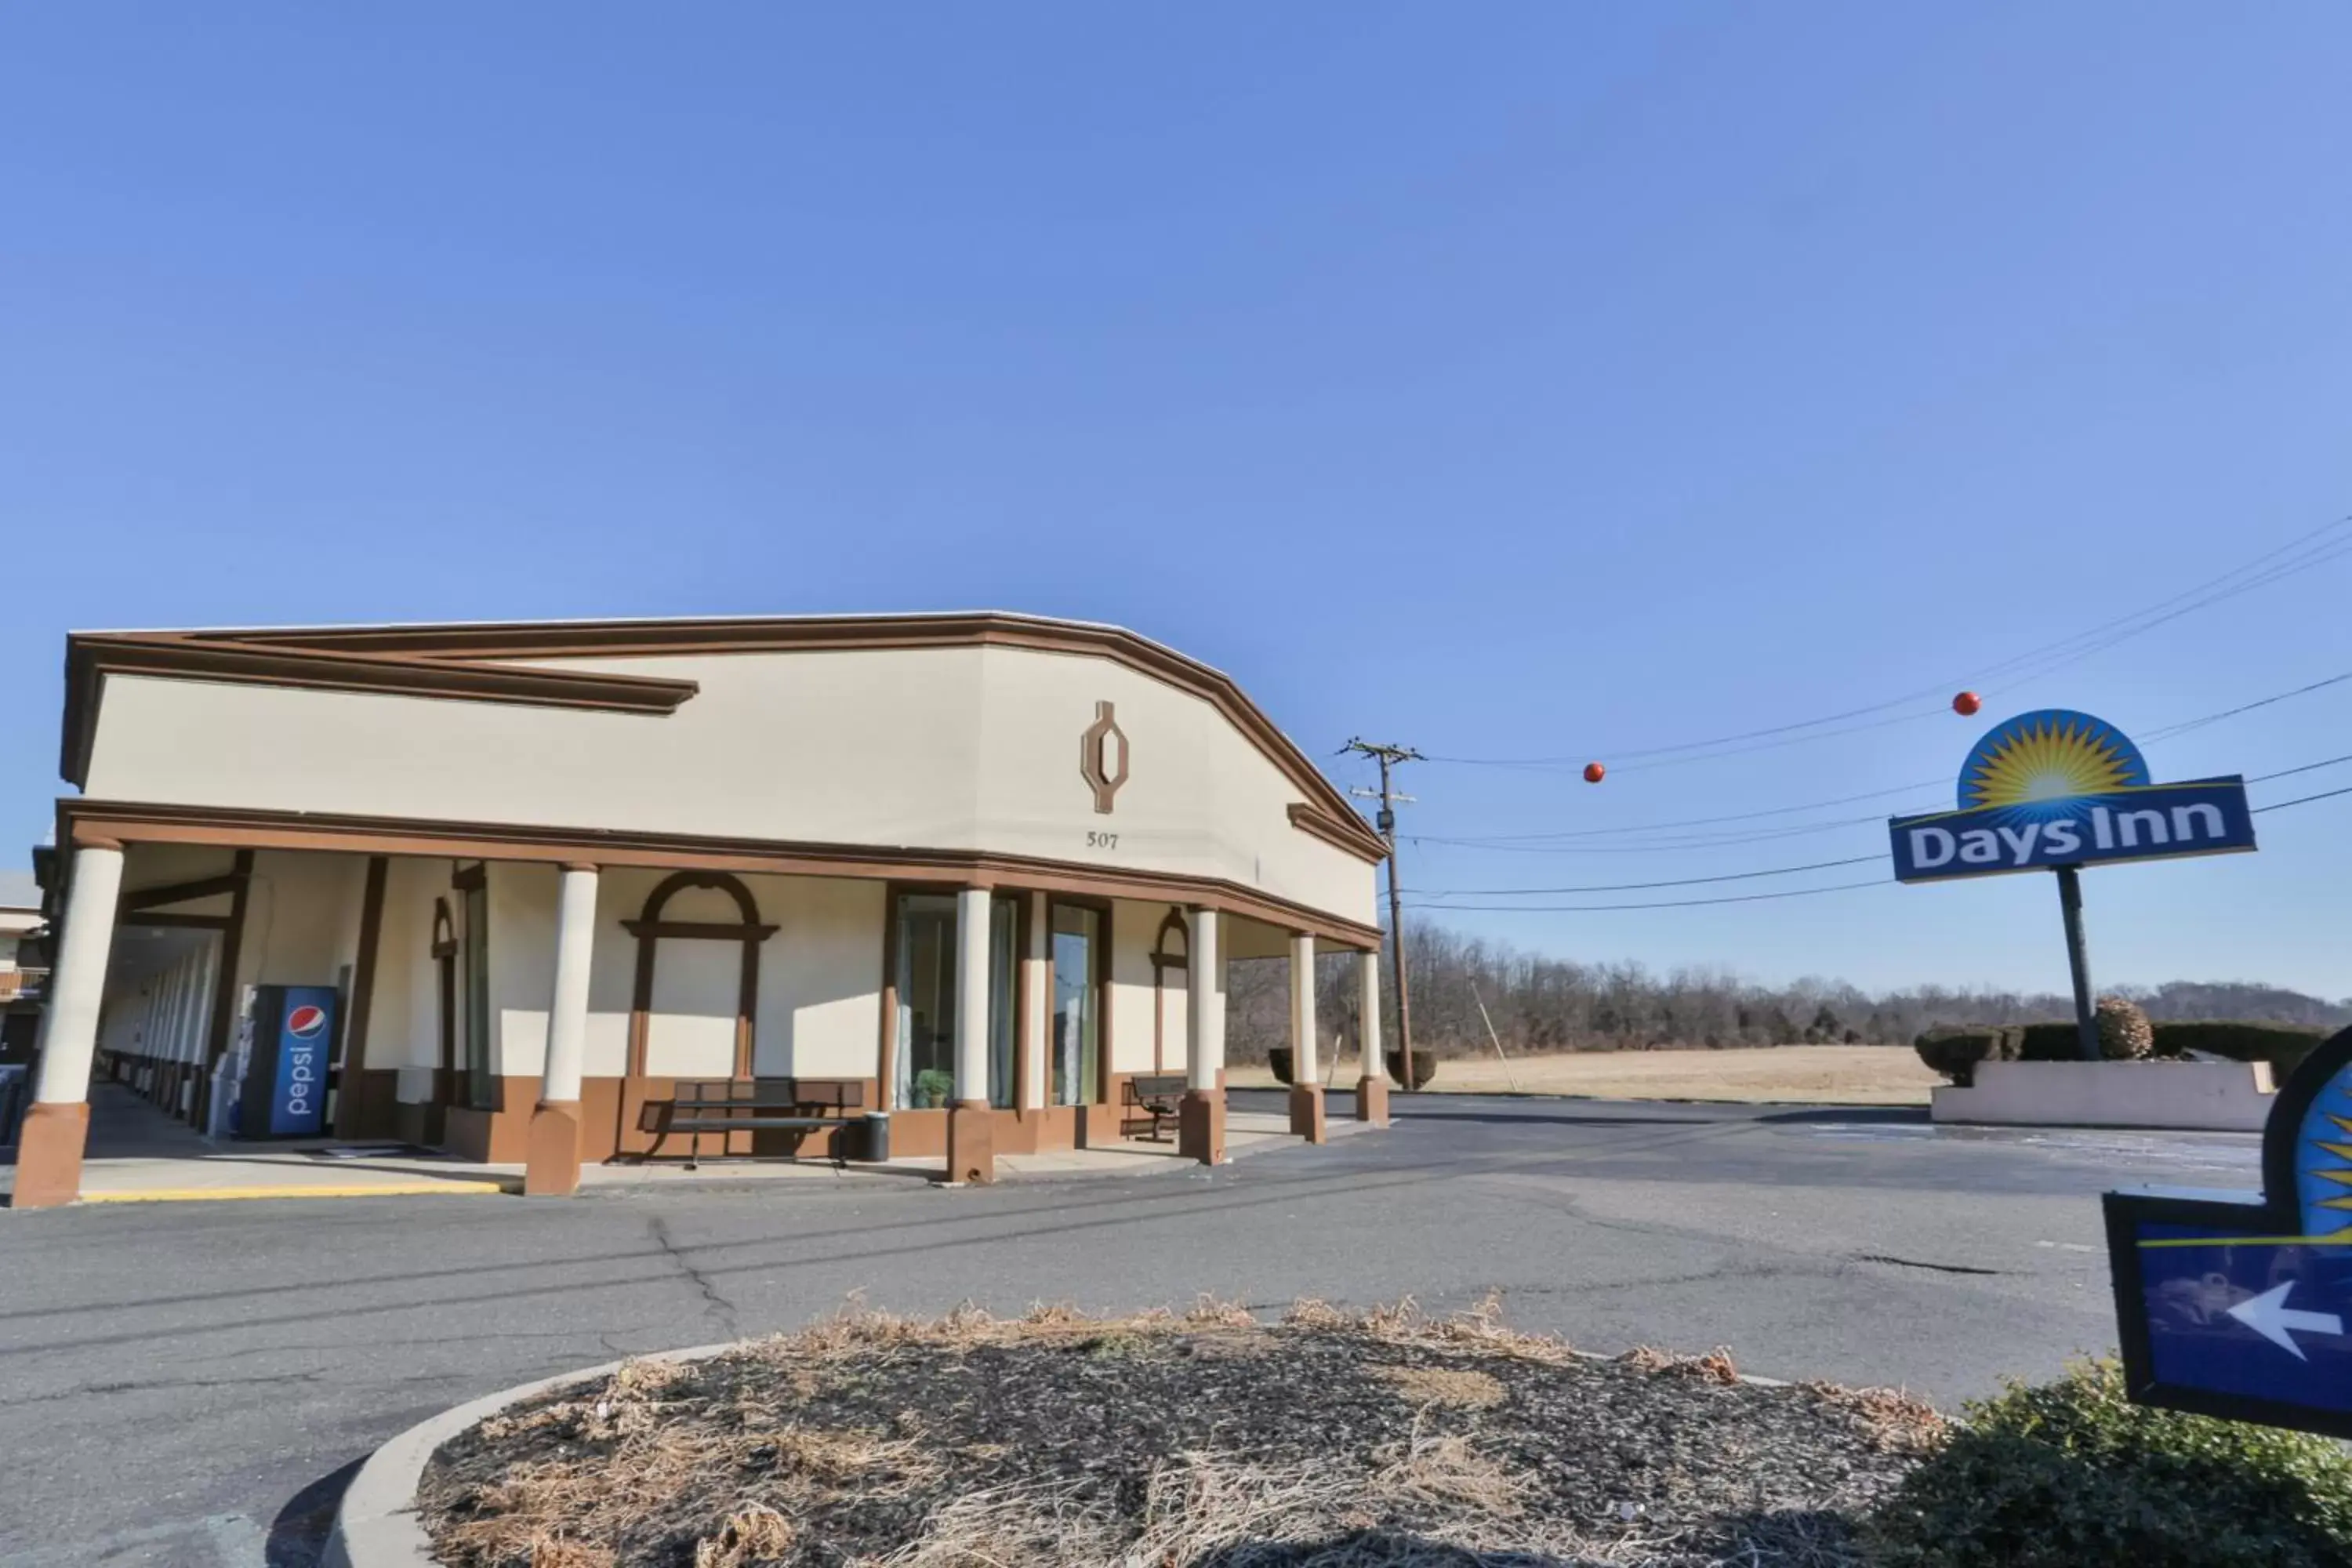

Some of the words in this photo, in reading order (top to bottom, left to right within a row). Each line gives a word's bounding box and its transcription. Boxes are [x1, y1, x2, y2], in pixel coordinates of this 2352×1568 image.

[1087, 831, 1119, 850] 507
[1909, 818, 2082, 869] Days
[2092, 802, 2226, 850] Inn
[287, 1045, 314, 1116] pepsi
